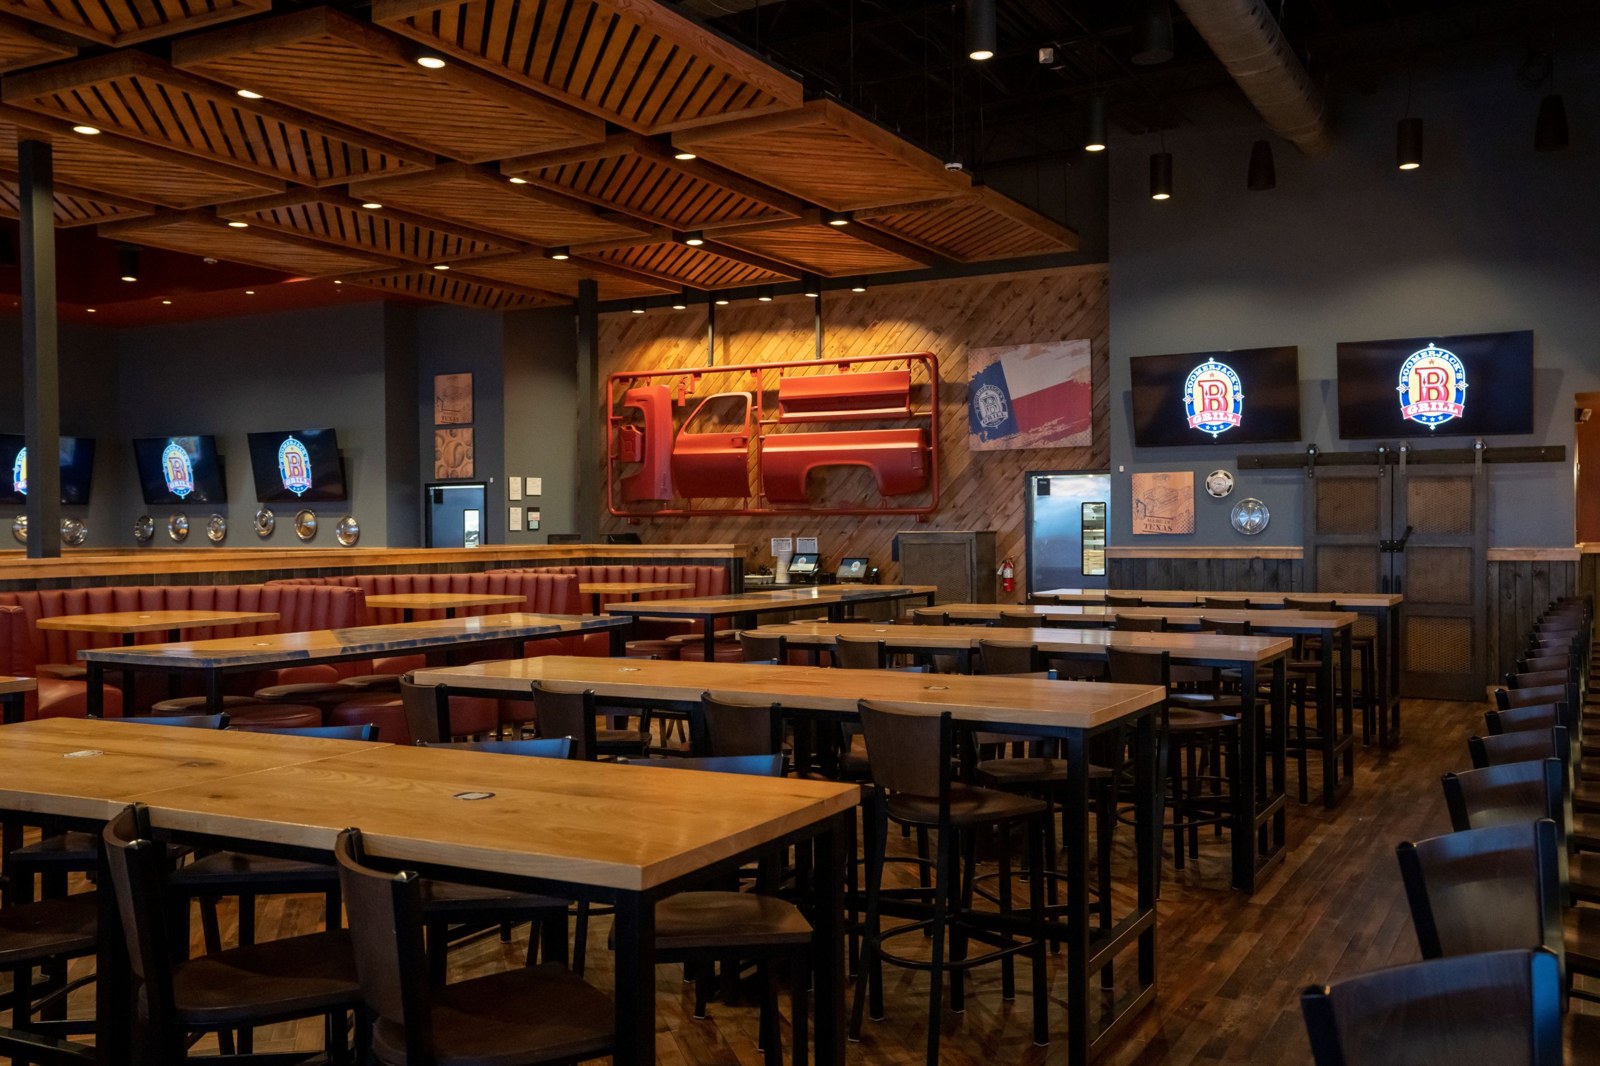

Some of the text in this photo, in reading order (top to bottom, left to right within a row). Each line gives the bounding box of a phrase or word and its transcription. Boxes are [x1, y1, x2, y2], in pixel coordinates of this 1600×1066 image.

[1187, 364, 1240, 394] BOOMERJACK'S
[1401, 350, 1463, 382] BOOMERJACK'S
[1198, 380, 1228, 412] B
[1415, 367, 1449, 403] B
[1192, 411, 1237, 424] GRILL
[1406, 402, 1459, 415] GRILL
[168, 456, 187, 481] B
[285, 451, 304, 478] B
[285, 477, 310, 486] GRILL
[1143, 522, 1174, 532] TEXAS
